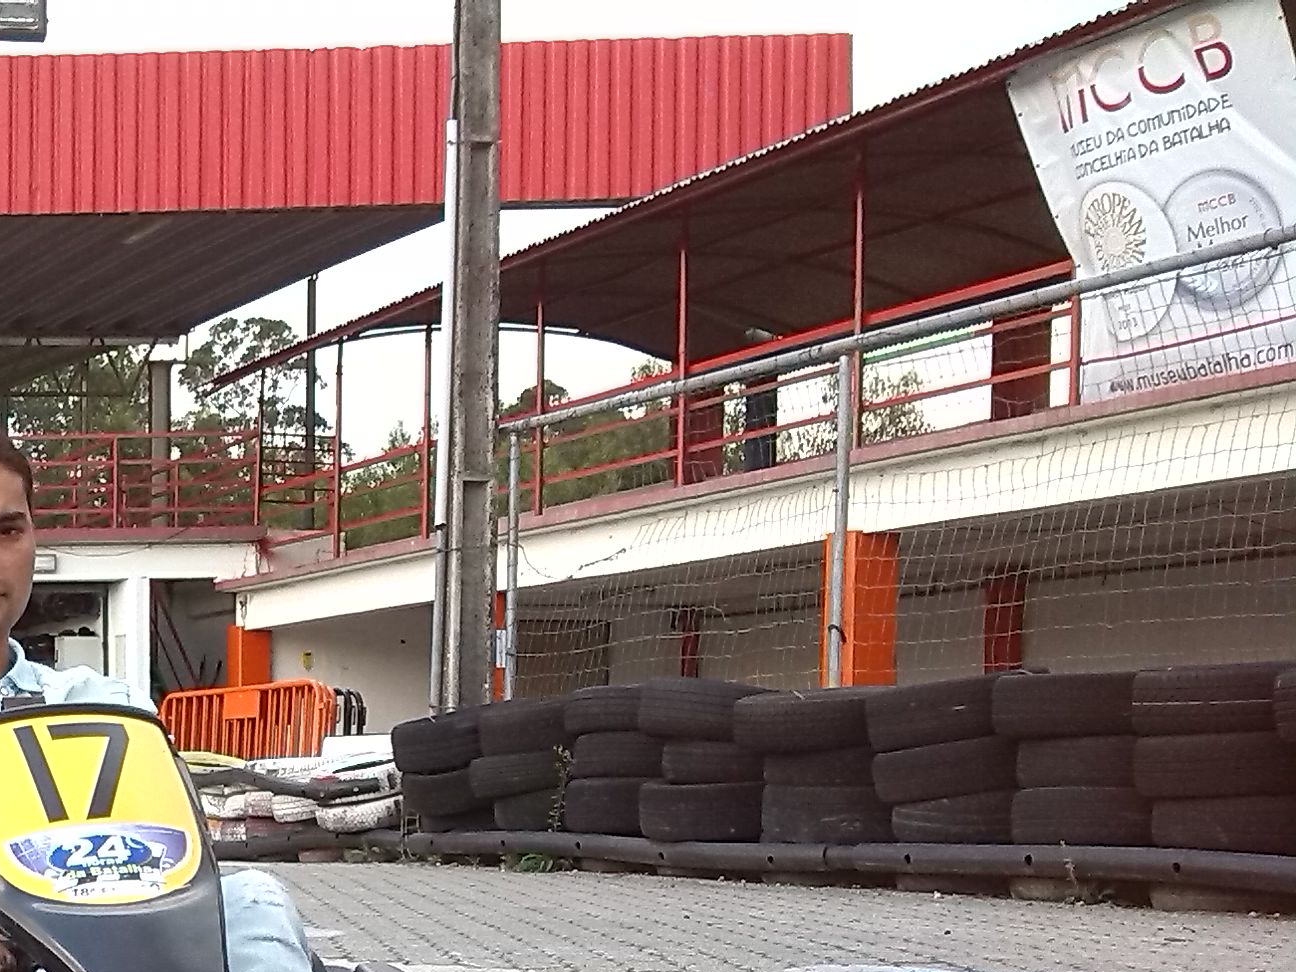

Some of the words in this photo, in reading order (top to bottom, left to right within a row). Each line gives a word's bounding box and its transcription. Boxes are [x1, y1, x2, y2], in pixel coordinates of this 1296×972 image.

[1106, 127, 1125, 146] DA
[1138, 139, 1159, 158] DA
[1162, 117, 1232, 151] BATALHA
[1187, 214, 1249, 242] Melhor
[12, 721, 130, 824] 17
[65, 834, 130, 868] 24
